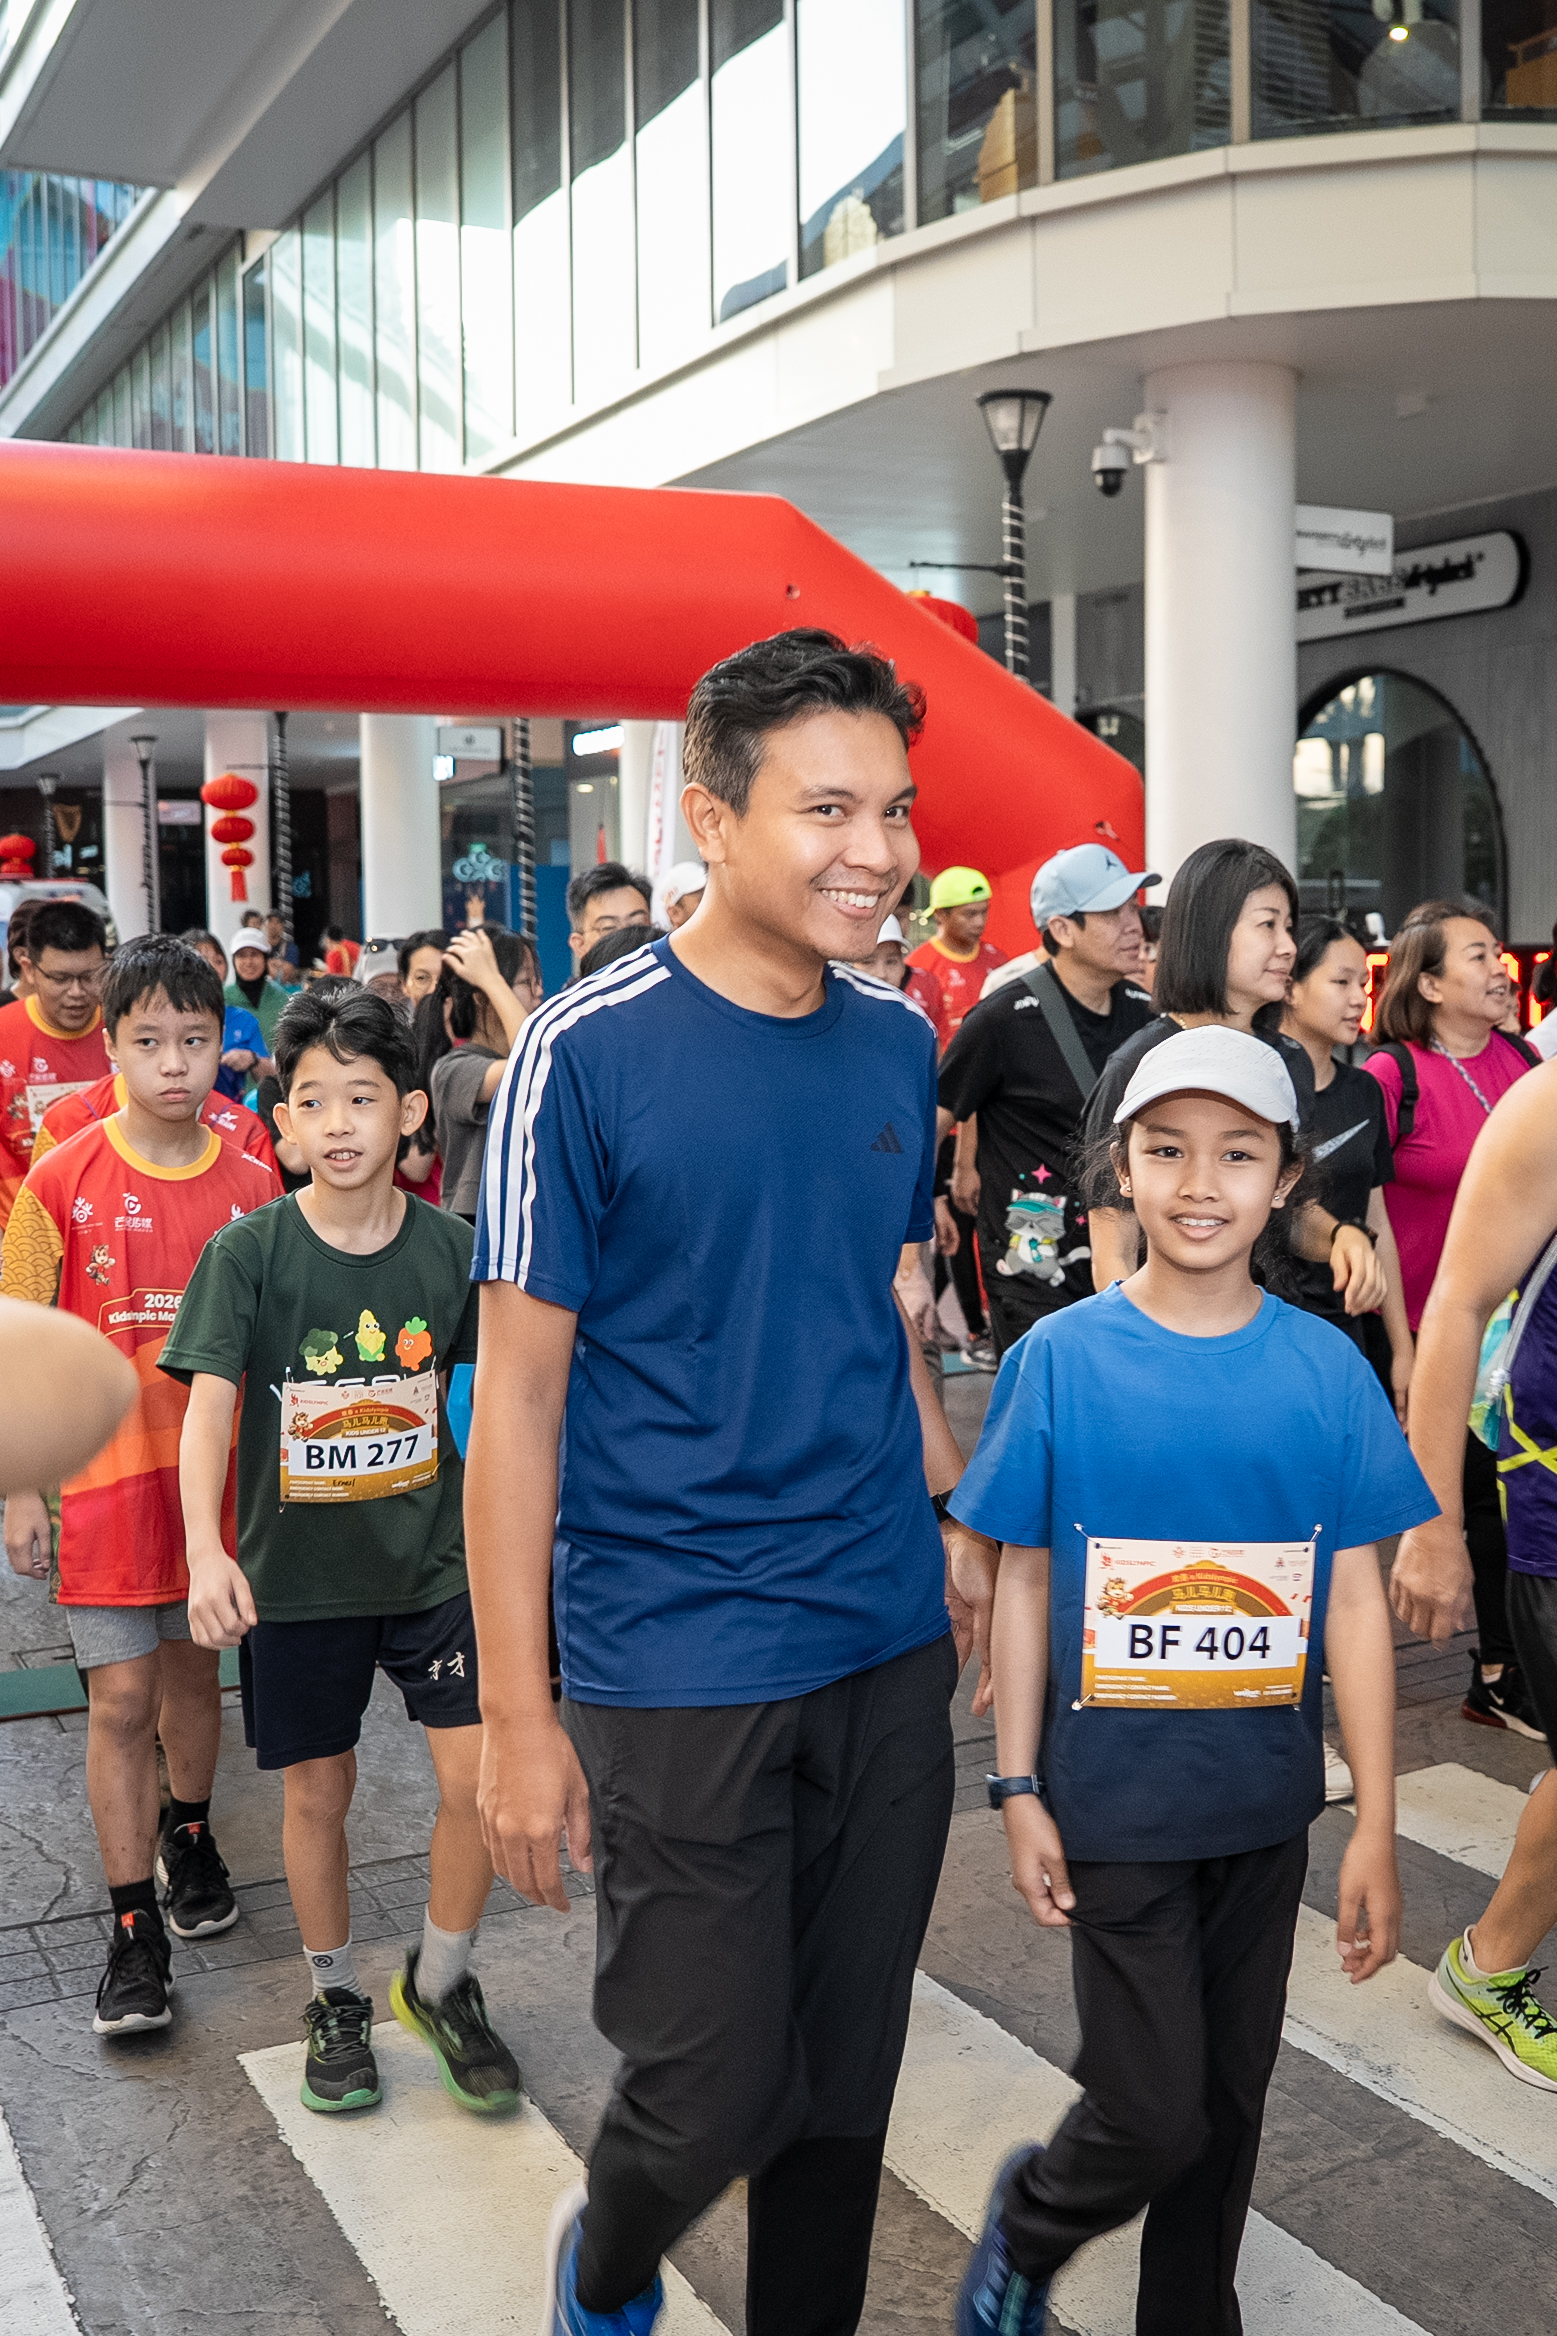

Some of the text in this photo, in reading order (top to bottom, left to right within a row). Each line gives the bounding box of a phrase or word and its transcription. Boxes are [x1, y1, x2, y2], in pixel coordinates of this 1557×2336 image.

[144, 1293, 183, 1309] 2026
[158, 1311, 176, 1322] Ma
[305, 1434, 419, 1469] BM 277
[1128, 1624, 1271, 1660] BF 404
